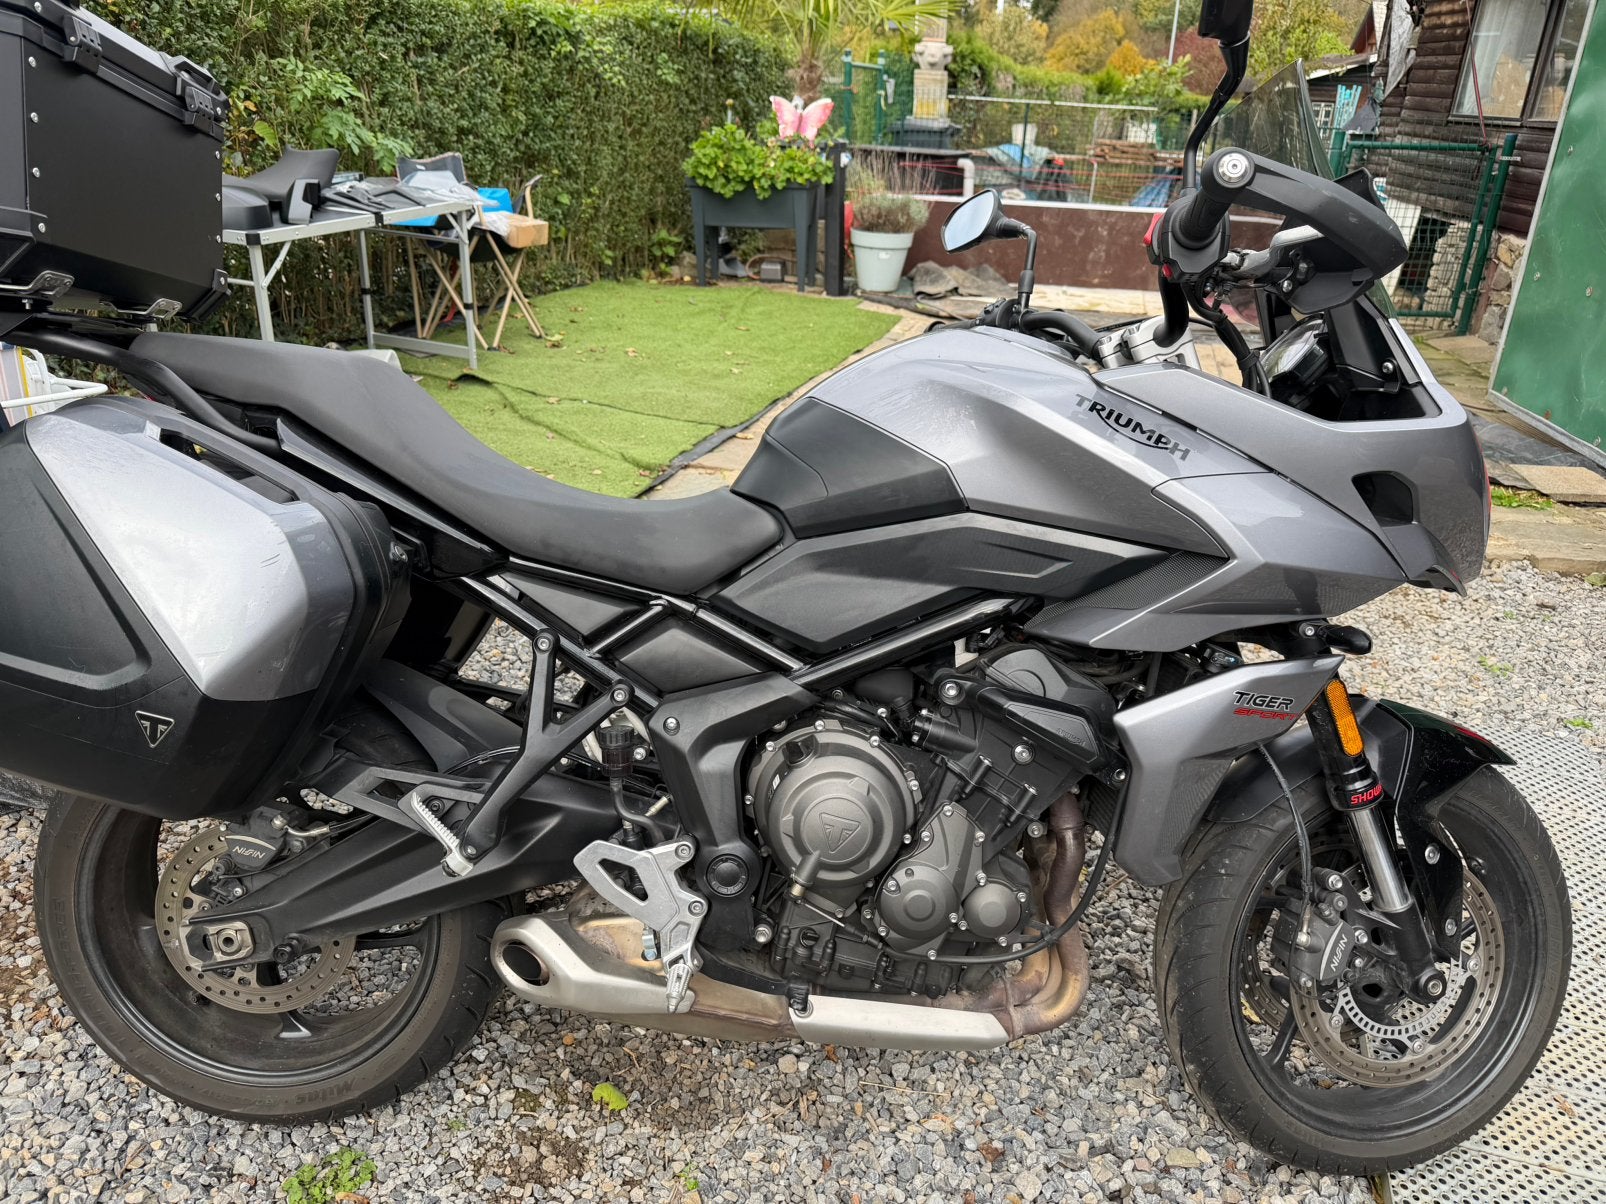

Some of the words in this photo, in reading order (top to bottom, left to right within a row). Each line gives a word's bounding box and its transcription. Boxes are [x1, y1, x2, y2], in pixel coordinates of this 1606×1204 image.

[1074, 393, 1191, 462] TRIUMPH
[1233, 690, 1295, 712] TIGER
[1233, 707, 1298, 721] SPORT
[1351, 784, 1383, 805] SHOW
